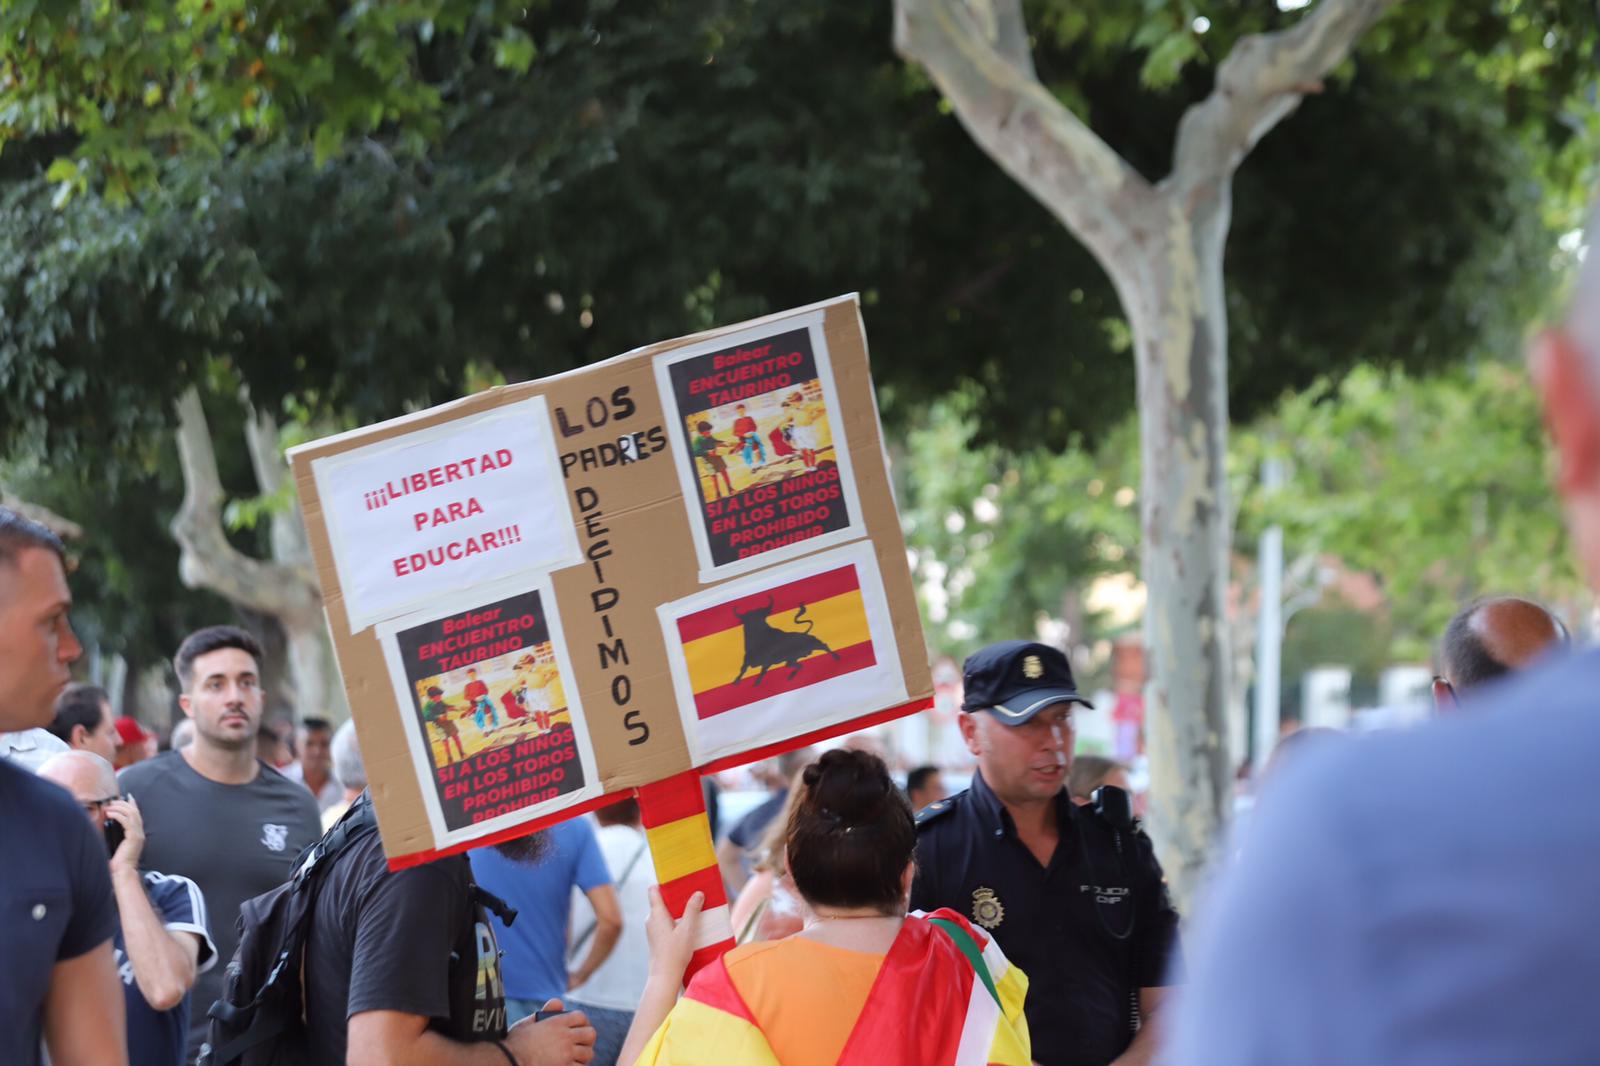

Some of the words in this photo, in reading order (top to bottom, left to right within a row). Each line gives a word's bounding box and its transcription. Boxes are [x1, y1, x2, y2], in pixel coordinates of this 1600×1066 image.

[688, 352, 803, 396] ENCUENTRO
[713, 344, 773, 370] Balear
[708, 373, 792, 407] TAURINO
[555, 386, 636, 438] LOS
[560, 425, 667, 478] PADRES
[413, 498, 484, 532] PARA
[711, 516, 737, 535] EN
[740, 504, 775, 525] LOS
[779, 484, 841, 513] TOROS
[727, 499, 741, 512] A
[744, 485, 778, 507] LOS
[729, 506, 830, 547] PROHIBIDO
[392, 524, 522, 577] EDUCAR!!!
[417, 614, 535, 661] ENCUENTRO
[442, 607, 502, 635] Balear
[437, 636, 523, 672] TAURINO
[444, 781, 470, 800] EN
[473, 767, 509, 790] LOS
[513, 746, 576, 777] TOROS
[459, 763, 473, 777] A
[476, 750, 512, 771] LOS
[463, 768, 565, 812] PROHIBIDO
